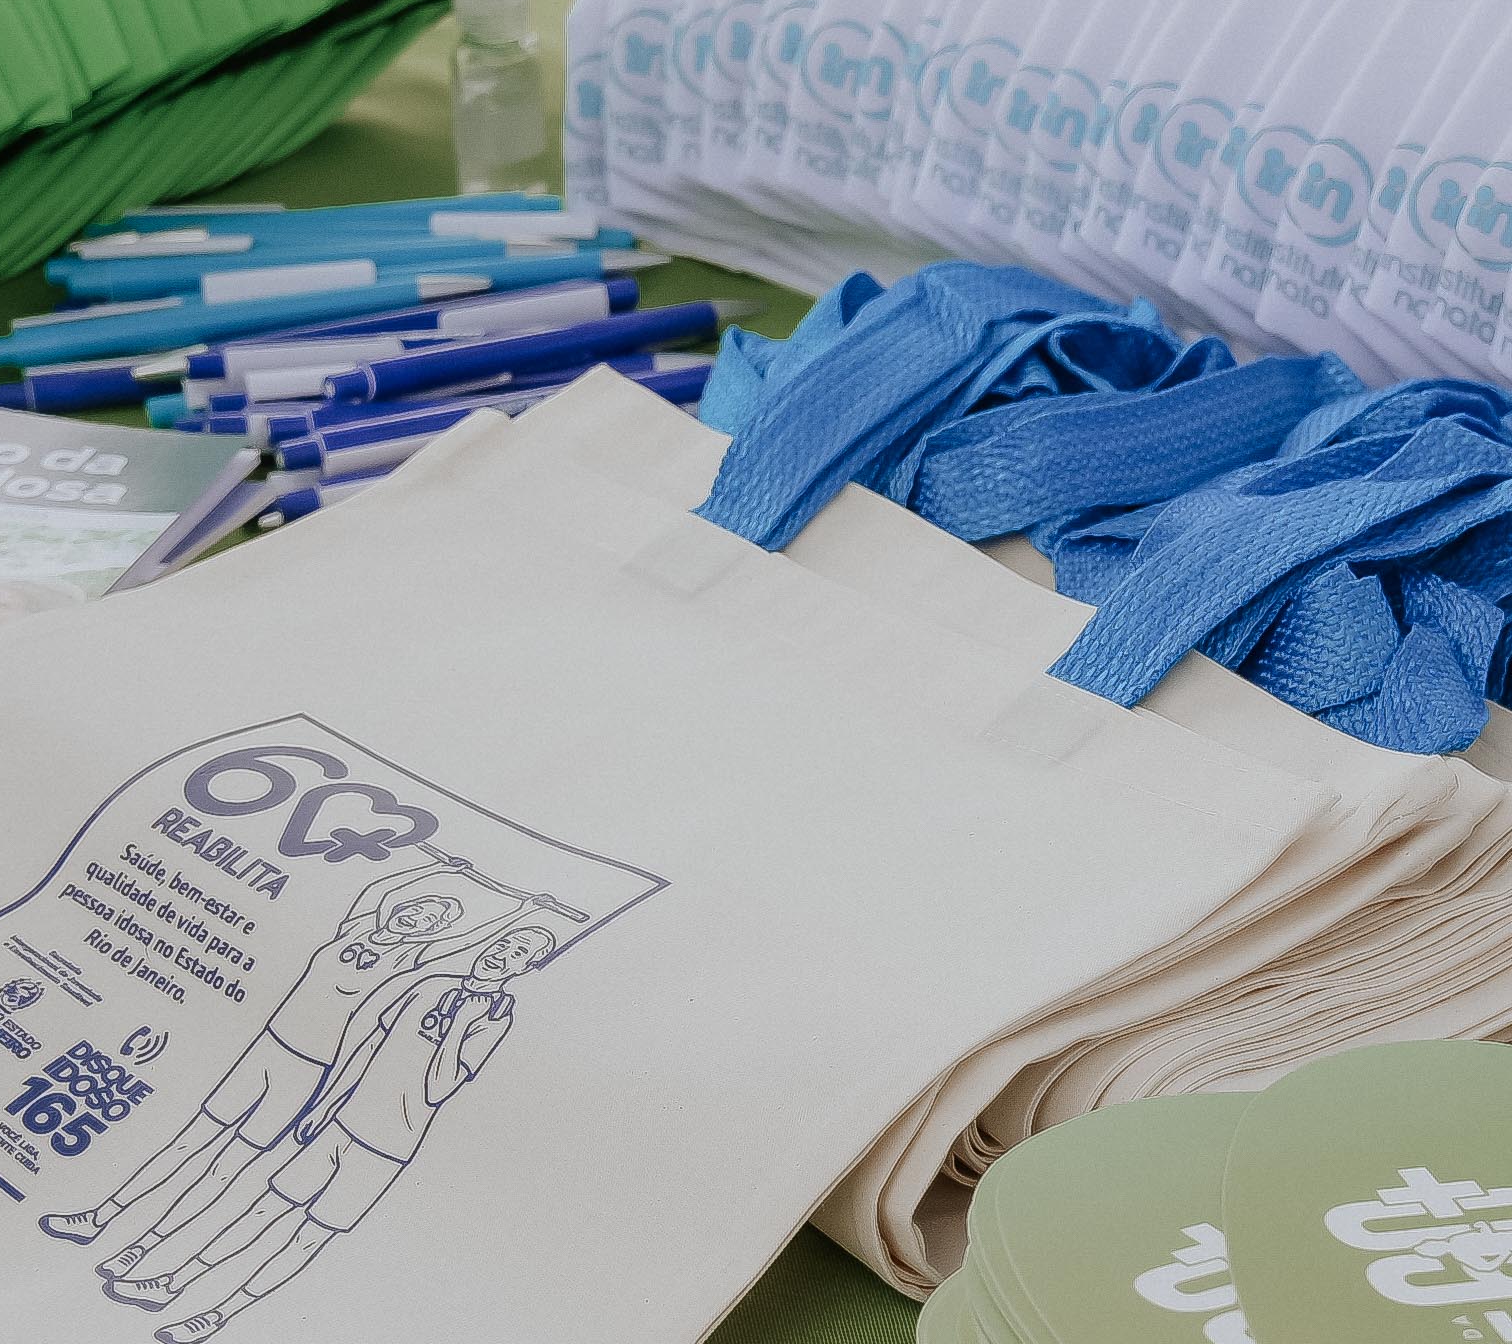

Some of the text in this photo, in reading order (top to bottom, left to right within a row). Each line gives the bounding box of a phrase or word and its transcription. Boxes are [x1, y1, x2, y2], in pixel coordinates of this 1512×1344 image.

[40, 446, 130, 477] da
[120, 843, 256, 935] Saúde, bem-estar e
[150, 807, 289, 900] REABILITA
[58, 883, 246, 1004] pessoa idosa no Estado do
[86, 861, 256, 972] qualidade de vida para a
[83, 928, 185, 1004] Rio de Janeiro.
[2, 1018, 43, 1051] ESTADO
[65, 1039, 156, 1106] DISQUE
[3, 1075, 110, 1157] 165
[41, 1054, 132, 1122] IDOSO
[1451, 1313, 1484, 1340] DA
